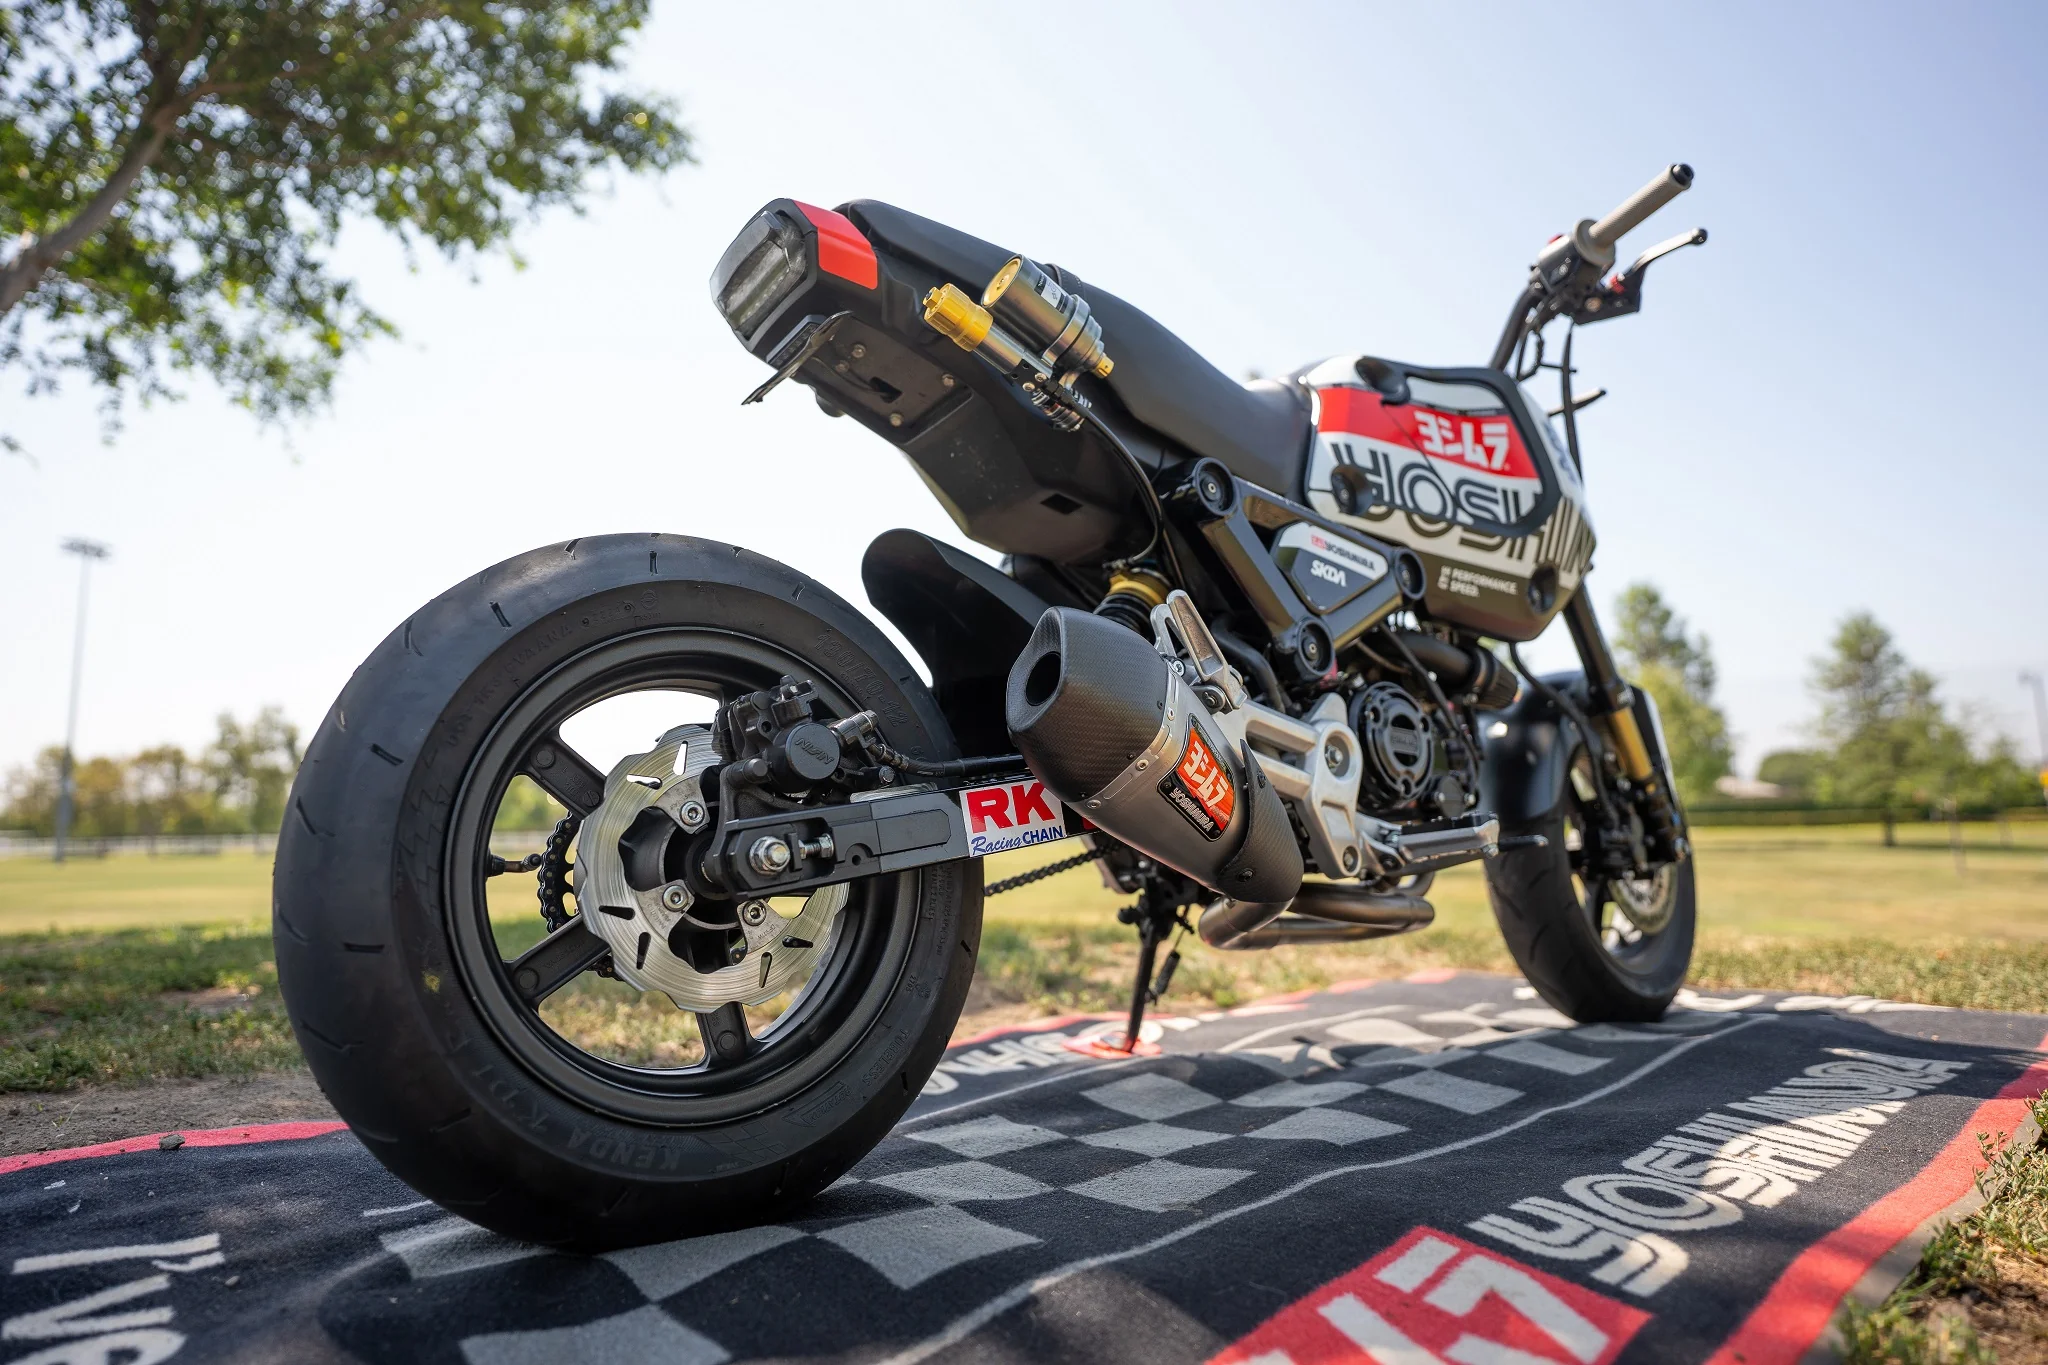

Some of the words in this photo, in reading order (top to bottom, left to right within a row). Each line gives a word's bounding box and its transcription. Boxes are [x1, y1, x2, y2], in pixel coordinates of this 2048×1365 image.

[966, 782, 1055, 833] RK
[971, 836, 1021, 855] Racing
[1022, 825, 1063, 844] CHAIN
[567, 1124, 682, 1174] KENDA
